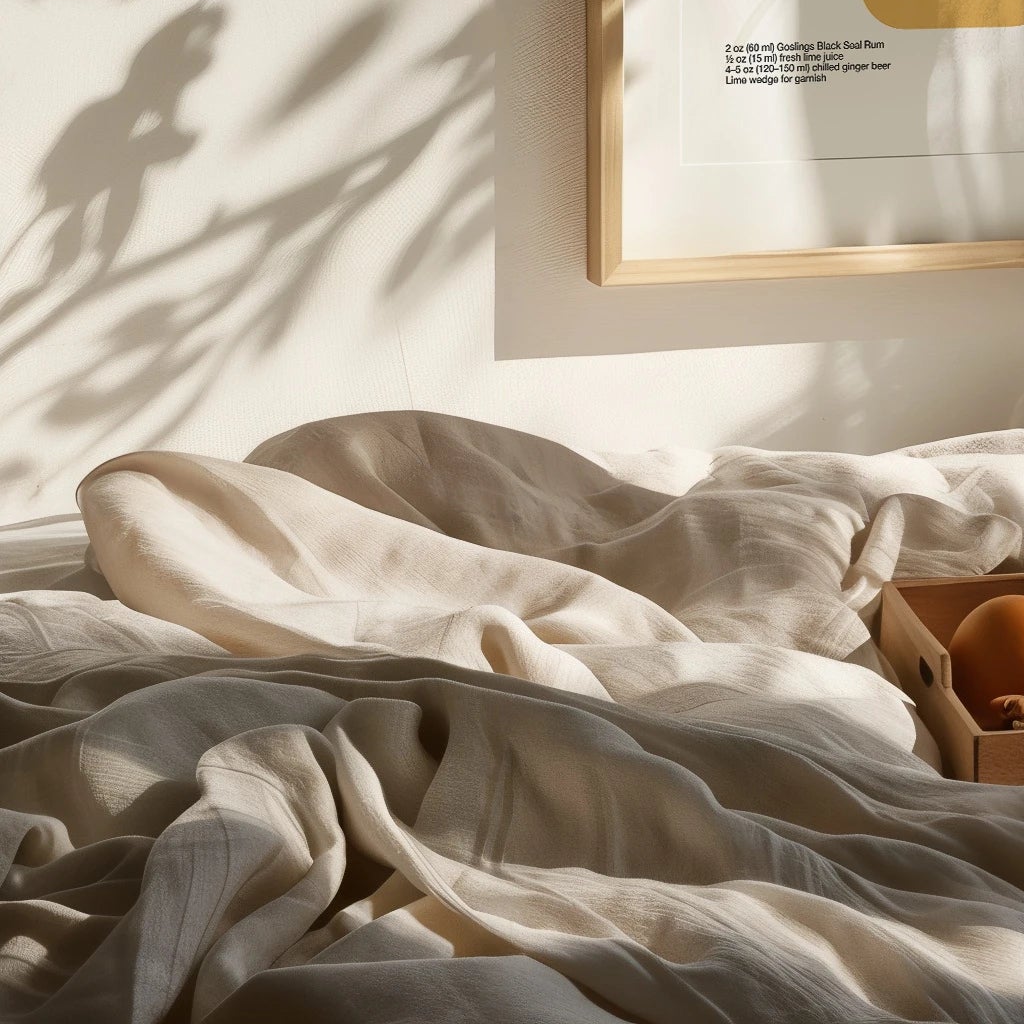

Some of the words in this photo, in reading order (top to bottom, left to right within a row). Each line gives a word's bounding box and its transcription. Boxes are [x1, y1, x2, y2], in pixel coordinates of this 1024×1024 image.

[725, 44, 731, 53] 2
[733, 45, 744, 53] oz
[746, 43, 759, 54] (60
[761, 42, 775, 54] ml)
[776, 41, 814, 53] Goslings
[817, 40, 841, 51] Black
[864, 39, 885, 50] Rum
[736, 56, 746, 64] oz
[748, 54, 762, 64] (15
[764, 53, 778, 64] ml)
[779, 53, 801, 63] fresh
[803, 52, 822, 62] lime
[823, 52, 844, 63] juice
[743, 66, 754, 74] oz
[796, 63, 810, 74] ml)
[812, 62, 840, 72] chilled
[842, 61, 869, 73] ginger
[871, 61, 891, 71] beer
[725, 75, 747, 85] Lime
[749, 75, 778, 86] wedge
[781, 74, 793, 83] for
[794, 73, 827, 85] garnish
